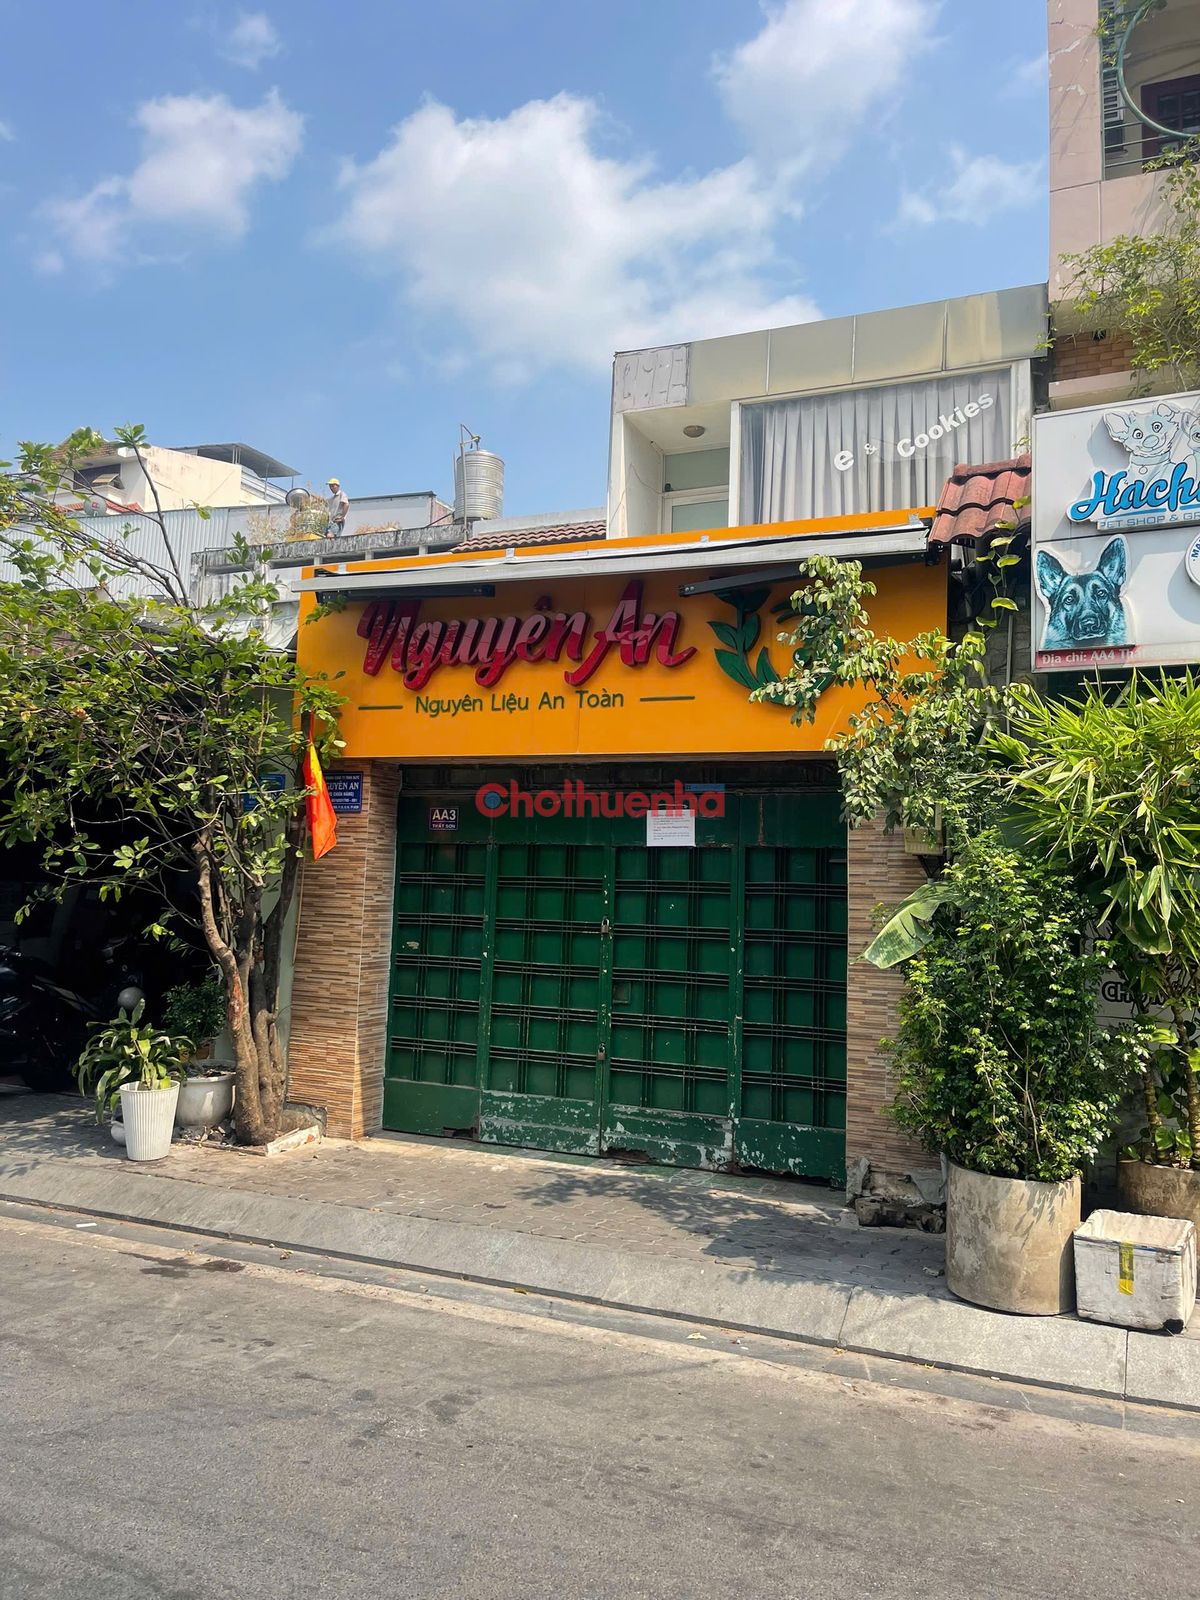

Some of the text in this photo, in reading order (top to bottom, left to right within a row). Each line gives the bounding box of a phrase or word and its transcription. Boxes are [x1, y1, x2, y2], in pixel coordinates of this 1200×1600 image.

[834, 393, 994, 471] e & Cookies
[1099, 519, 1122, 529] PET
[1127, 515, 1166, 528] SHOP
[1169, 512, 1179, 523] &
[564, 579, 698, 687] An
[1042, 653, 1062, 666] Địa
[1090, 649, 1115, 662] AA4
[415, 694, 483, 718] Nguyên
[538, 691, 565, 710] An
[574, 688, 624, 708] Toàn
[349, 781, 359, 790] AN
[432, 809, 456, 820] AA3
